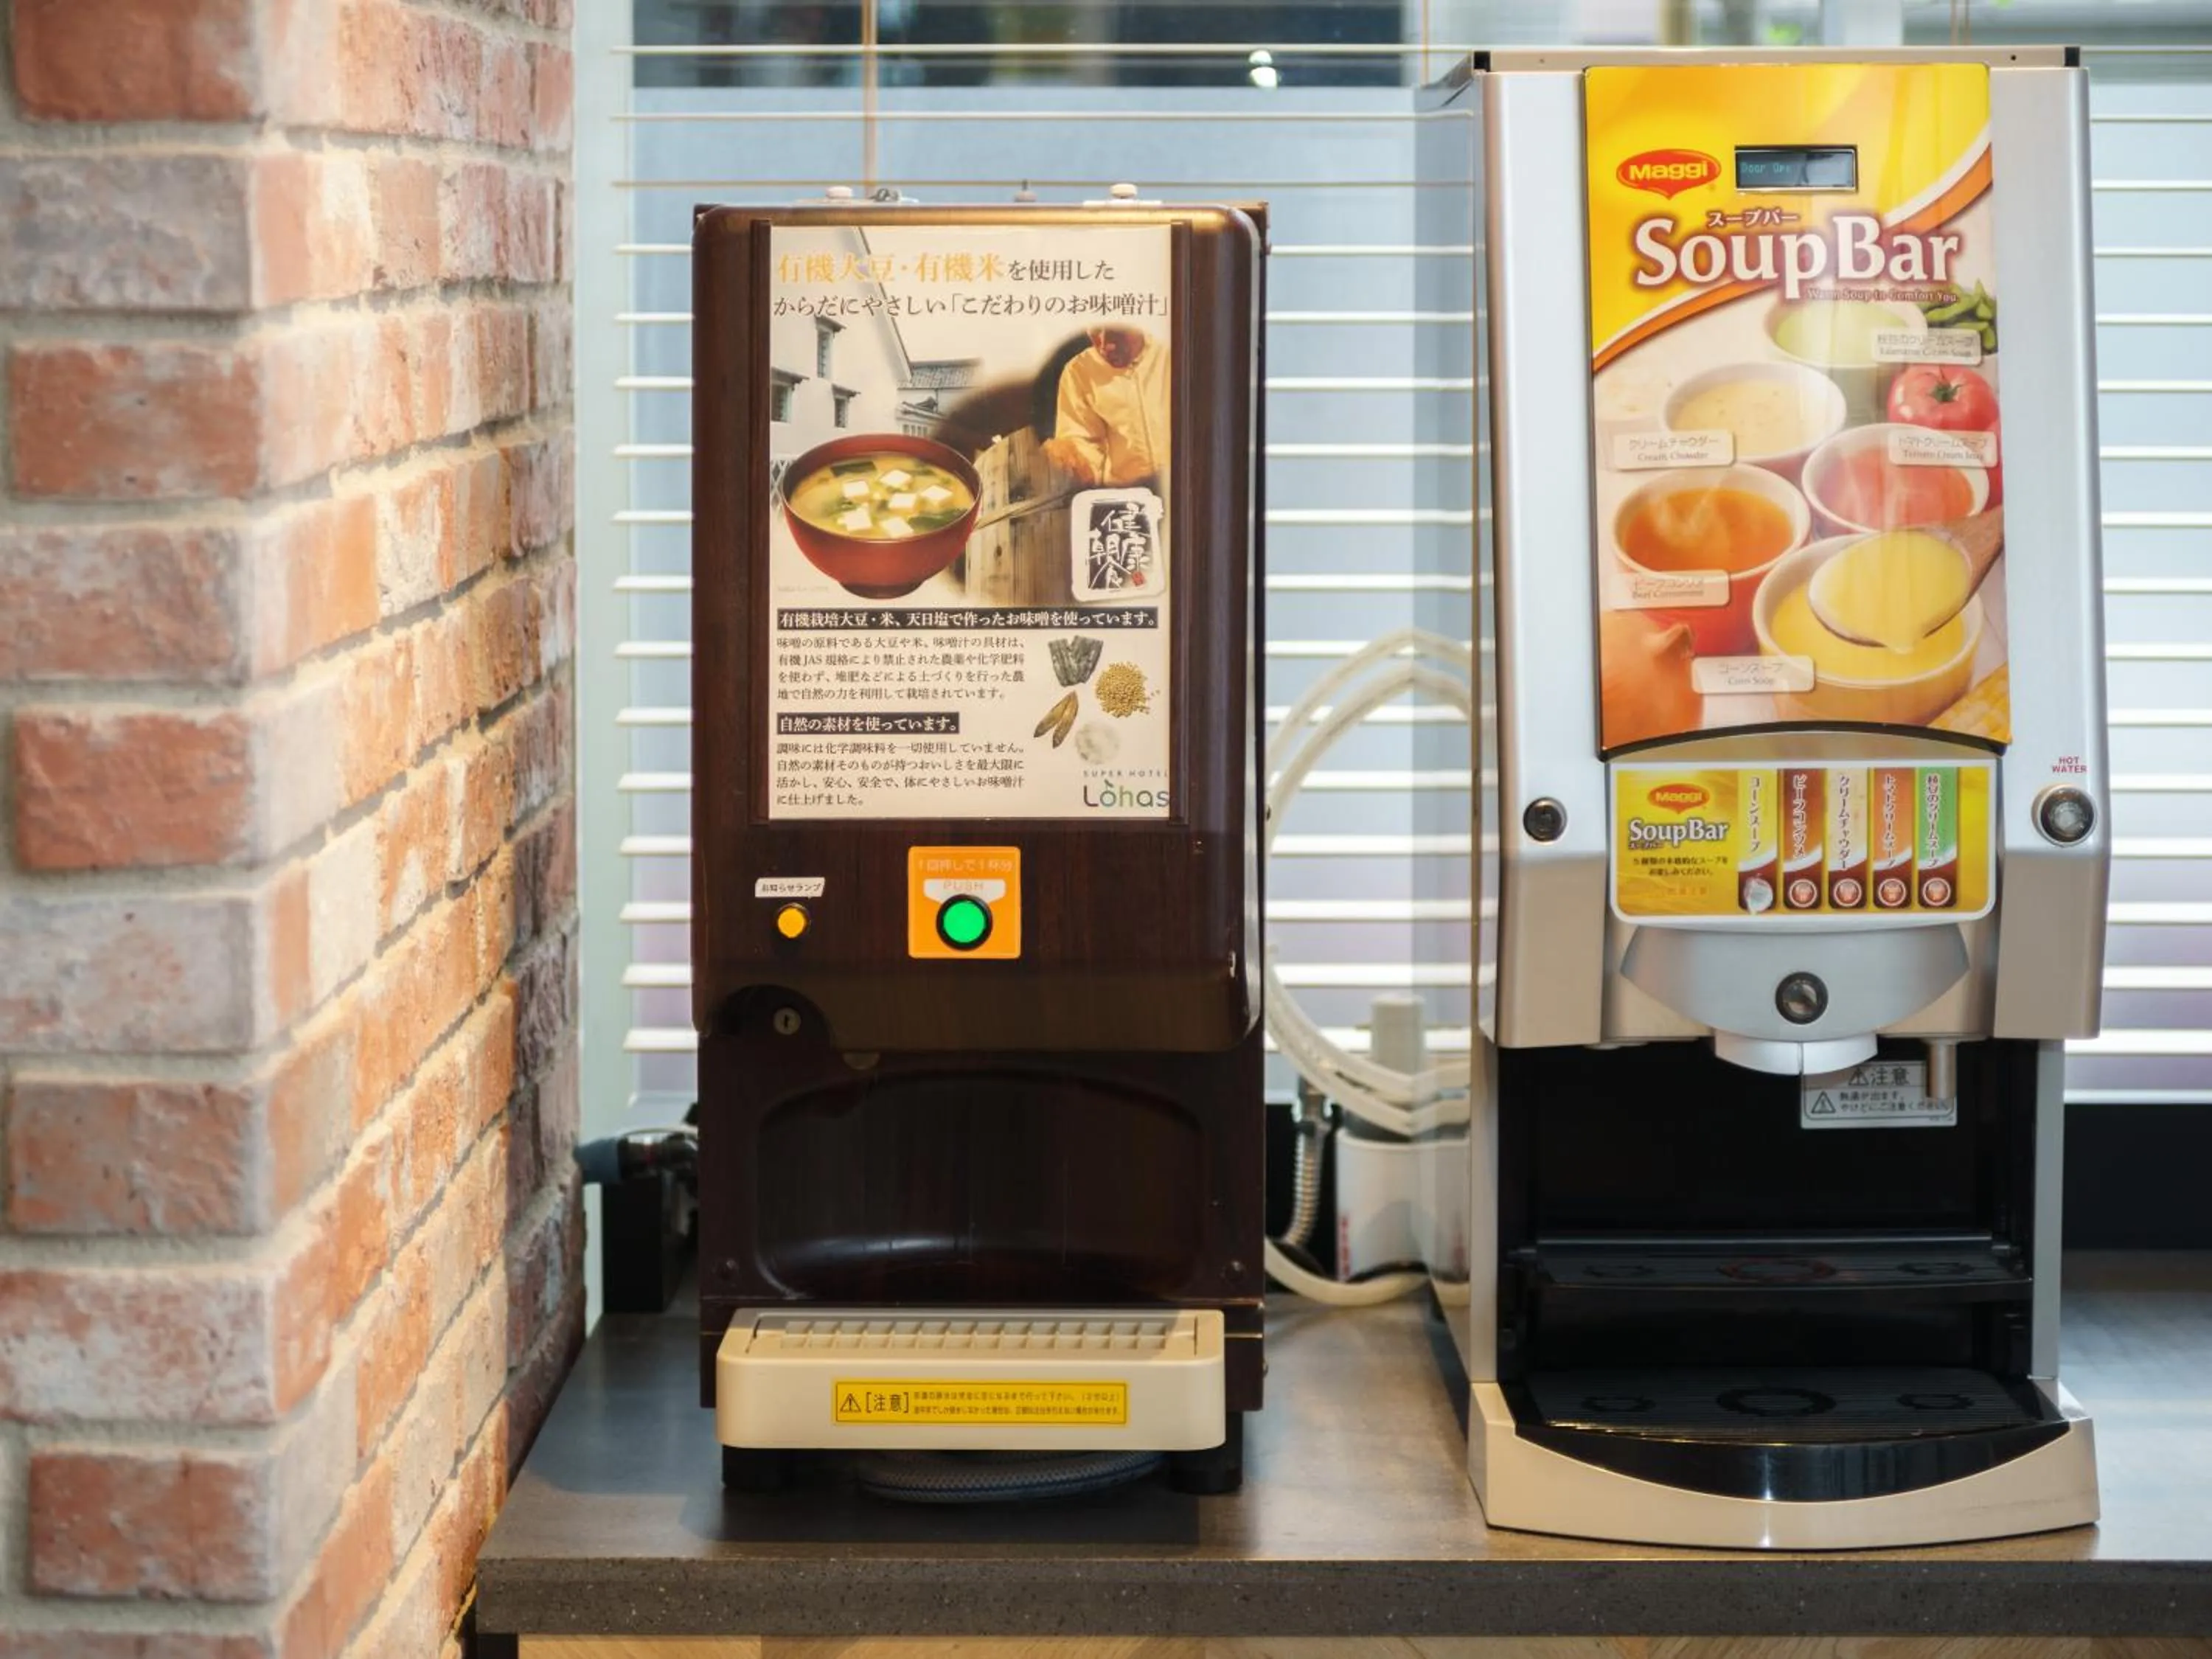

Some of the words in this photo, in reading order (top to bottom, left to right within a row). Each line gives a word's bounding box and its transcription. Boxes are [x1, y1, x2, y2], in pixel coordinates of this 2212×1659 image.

[1628, 160, 1708, 180] Maggi
[1708, 209, 1798, 227] スープバー
[778, 253, 1115, 284] 有機大豆・有機米を使用した
[773, 293, 1169, 317] からだにやさしい「こだわりのお味噌汁」
[779, 717, 957, 732] 自然の素材を使っています。
[2059, 756, 2080, 764] HOT
